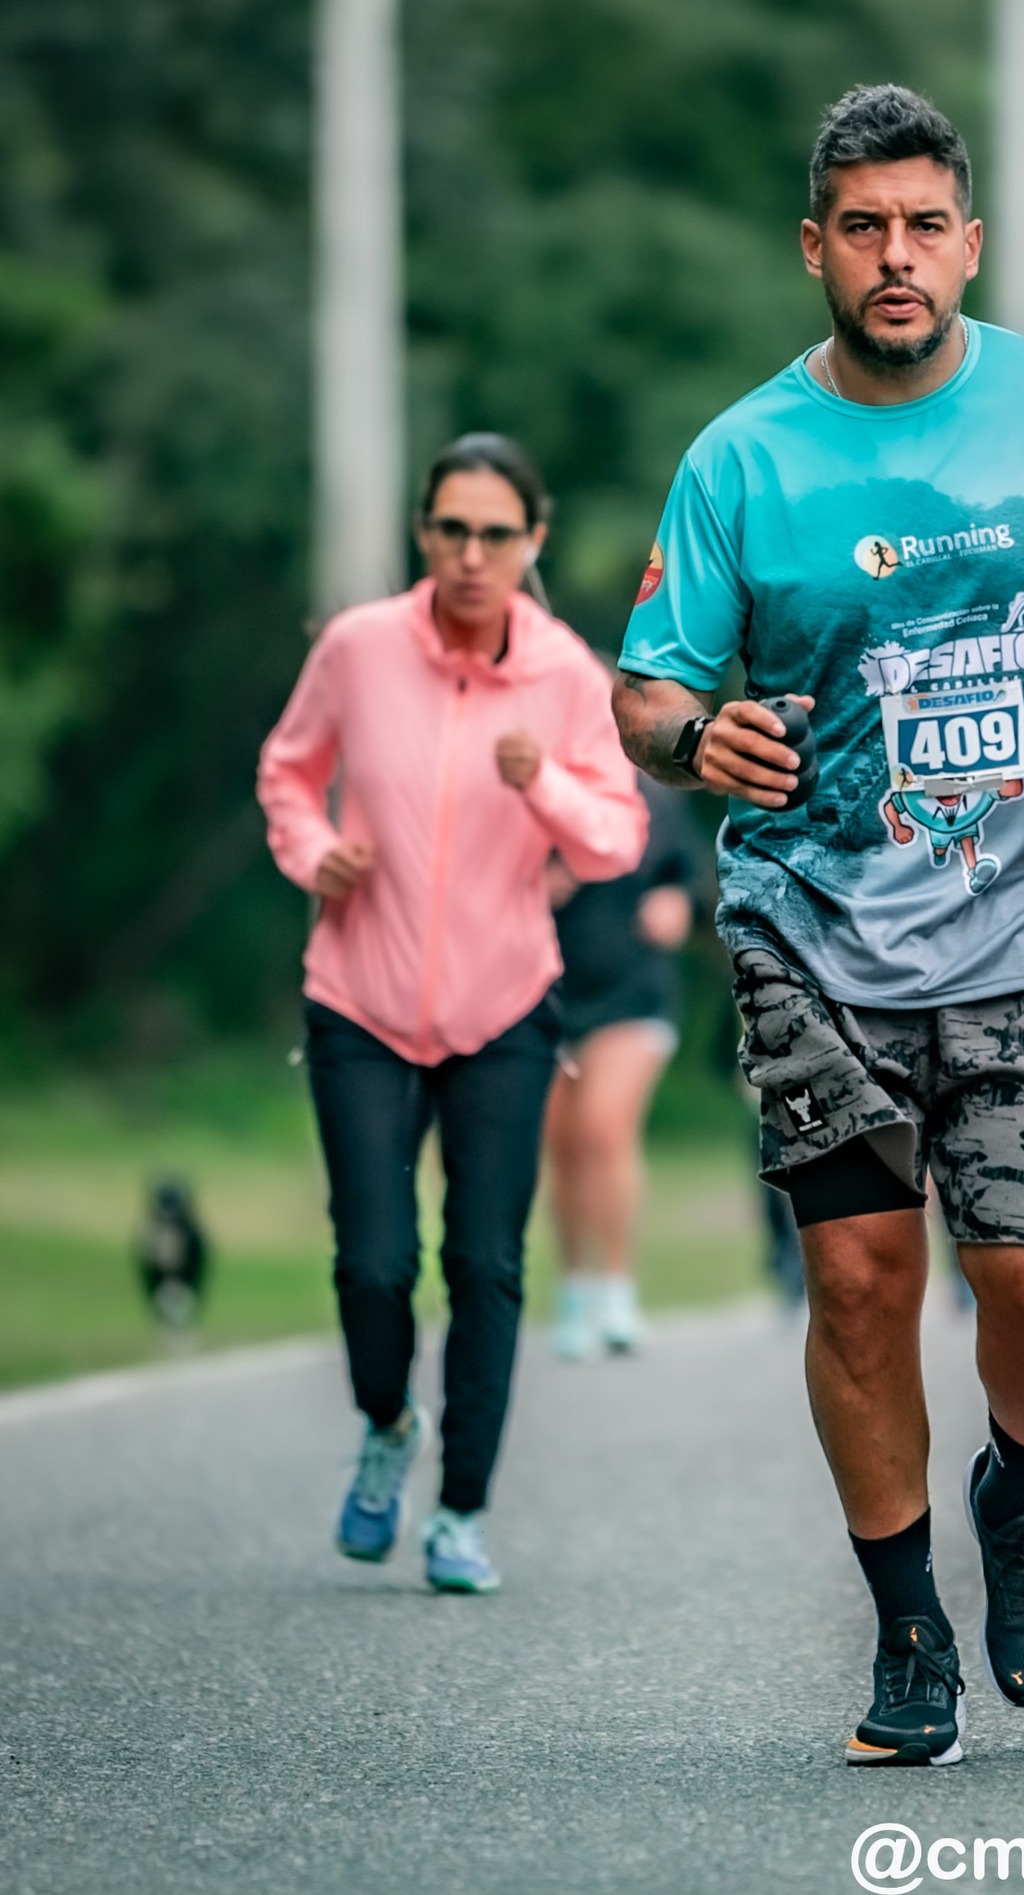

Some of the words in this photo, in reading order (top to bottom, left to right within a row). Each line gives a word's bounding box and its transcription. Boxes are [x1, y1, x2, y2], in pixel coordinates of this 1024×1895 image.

[900, 522, 1015, 560] Running
[902, 619, 956, 638] Enfermedad
[918, 690, 994, 710] DESAFIO
[910, 711, 1017, 770] 409
